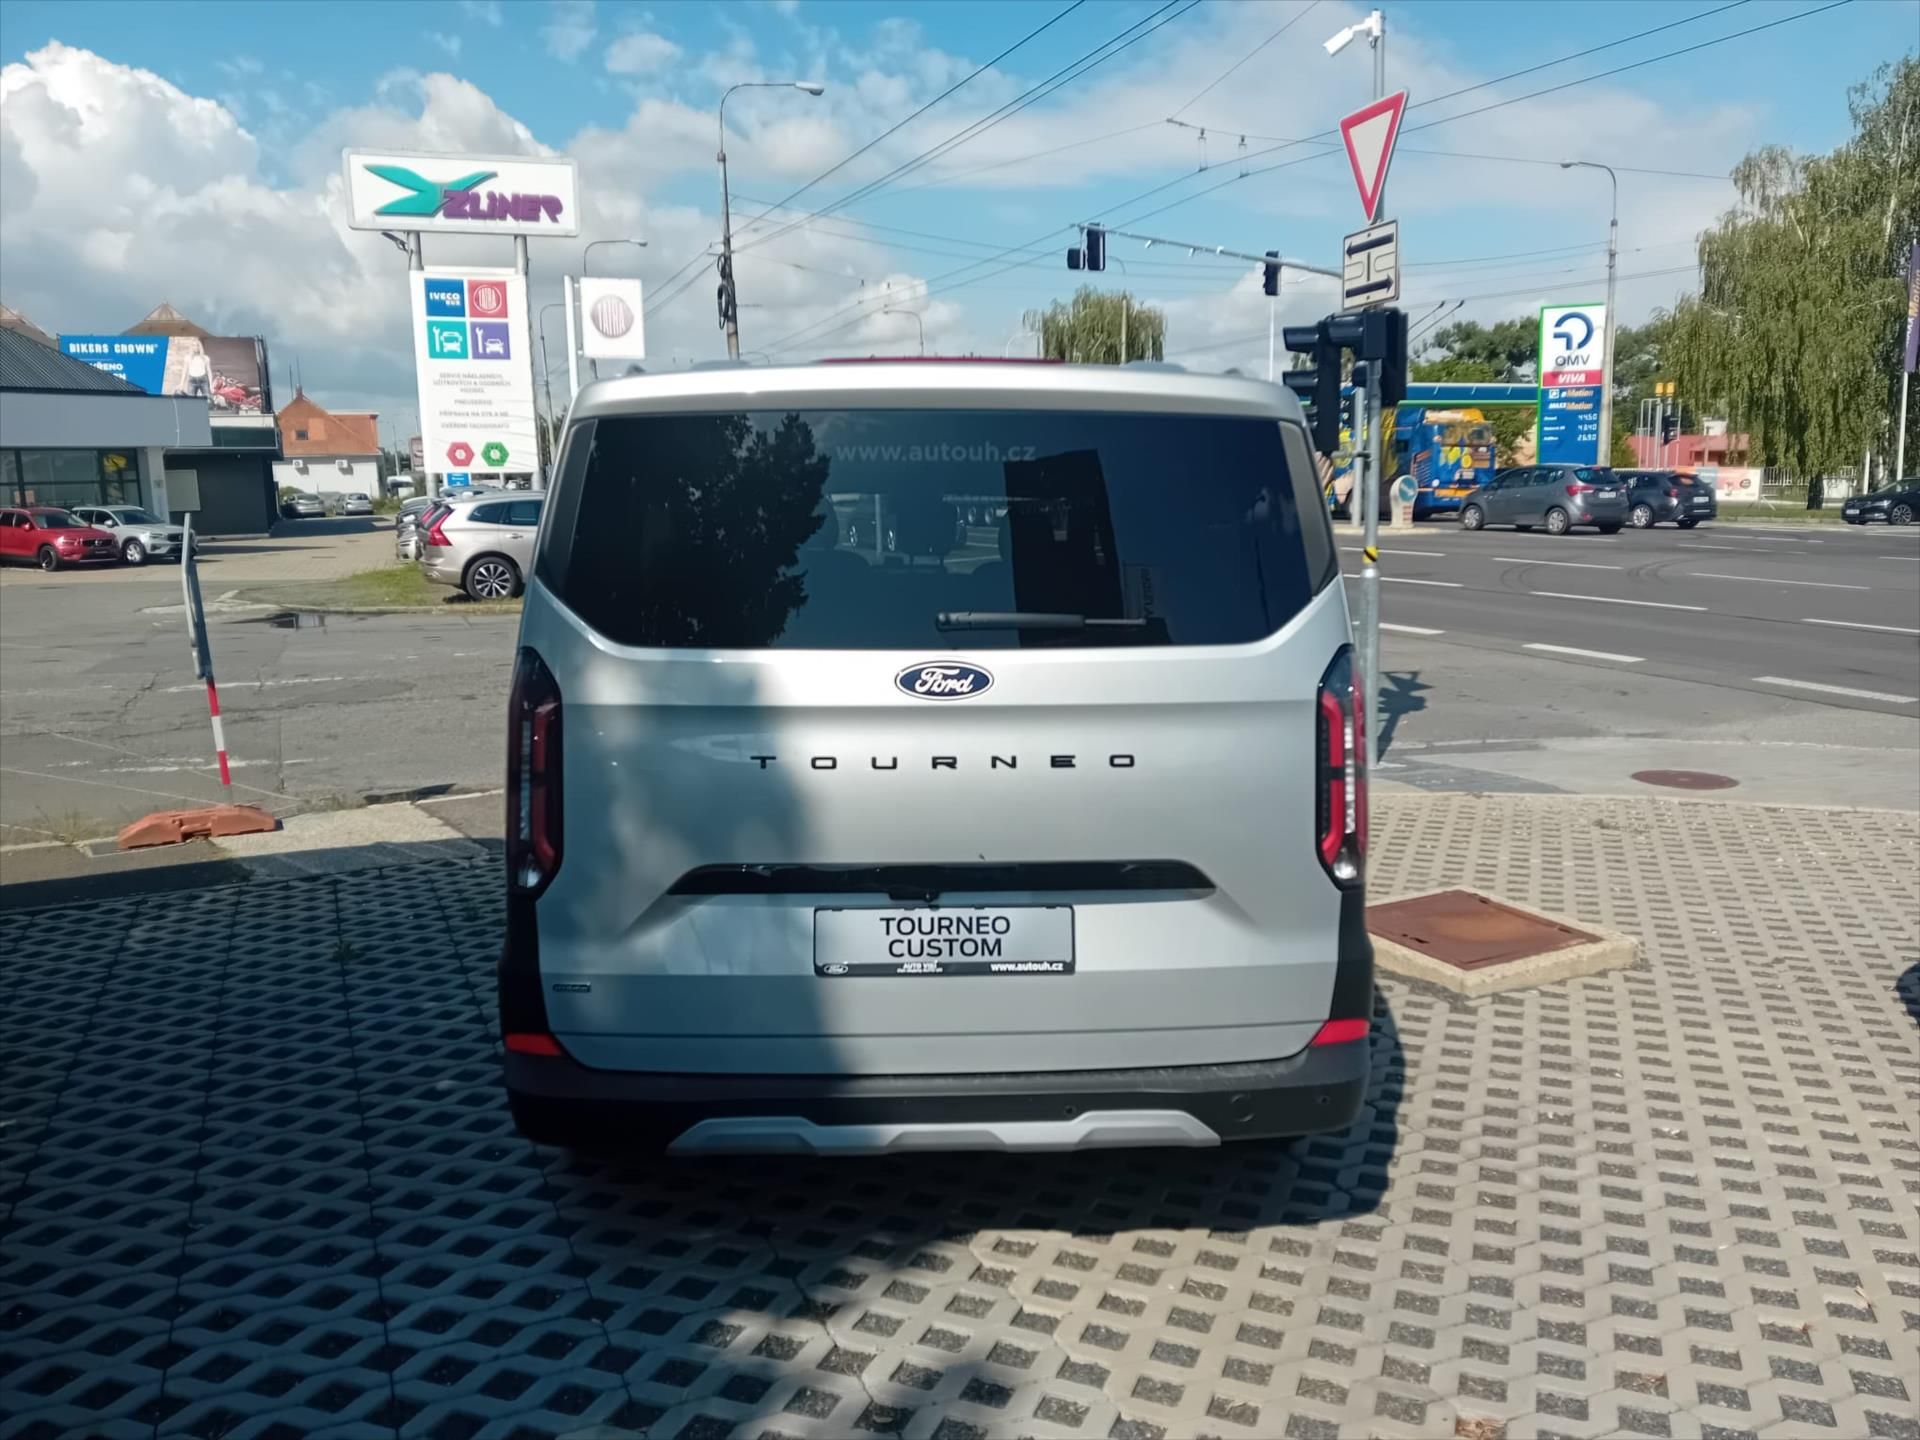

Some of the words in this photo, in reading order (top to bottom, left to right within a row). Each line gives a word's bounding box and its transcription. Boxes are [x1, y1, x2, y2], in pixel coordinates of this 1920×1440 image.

[429, 292, 461, 300] IVECO
[69, 343, 109, 353] BIKERS
[114, 343, 154, 354] CROWN
[1555, 354, 1590, 367] OMV
[1558, 373, 1586, 384] VIVA
[836, 442, 1036, 462] www.autouh.cz
[915, 667, 974, 692] Ford
[750, 754, 1135, 770] TOURNEO
[879, 916, 1010, 936] TOURNEO
[888, 938, 1002, 958] CUSTOM
[990, 962, 1064, 971] www.autouh.cz
